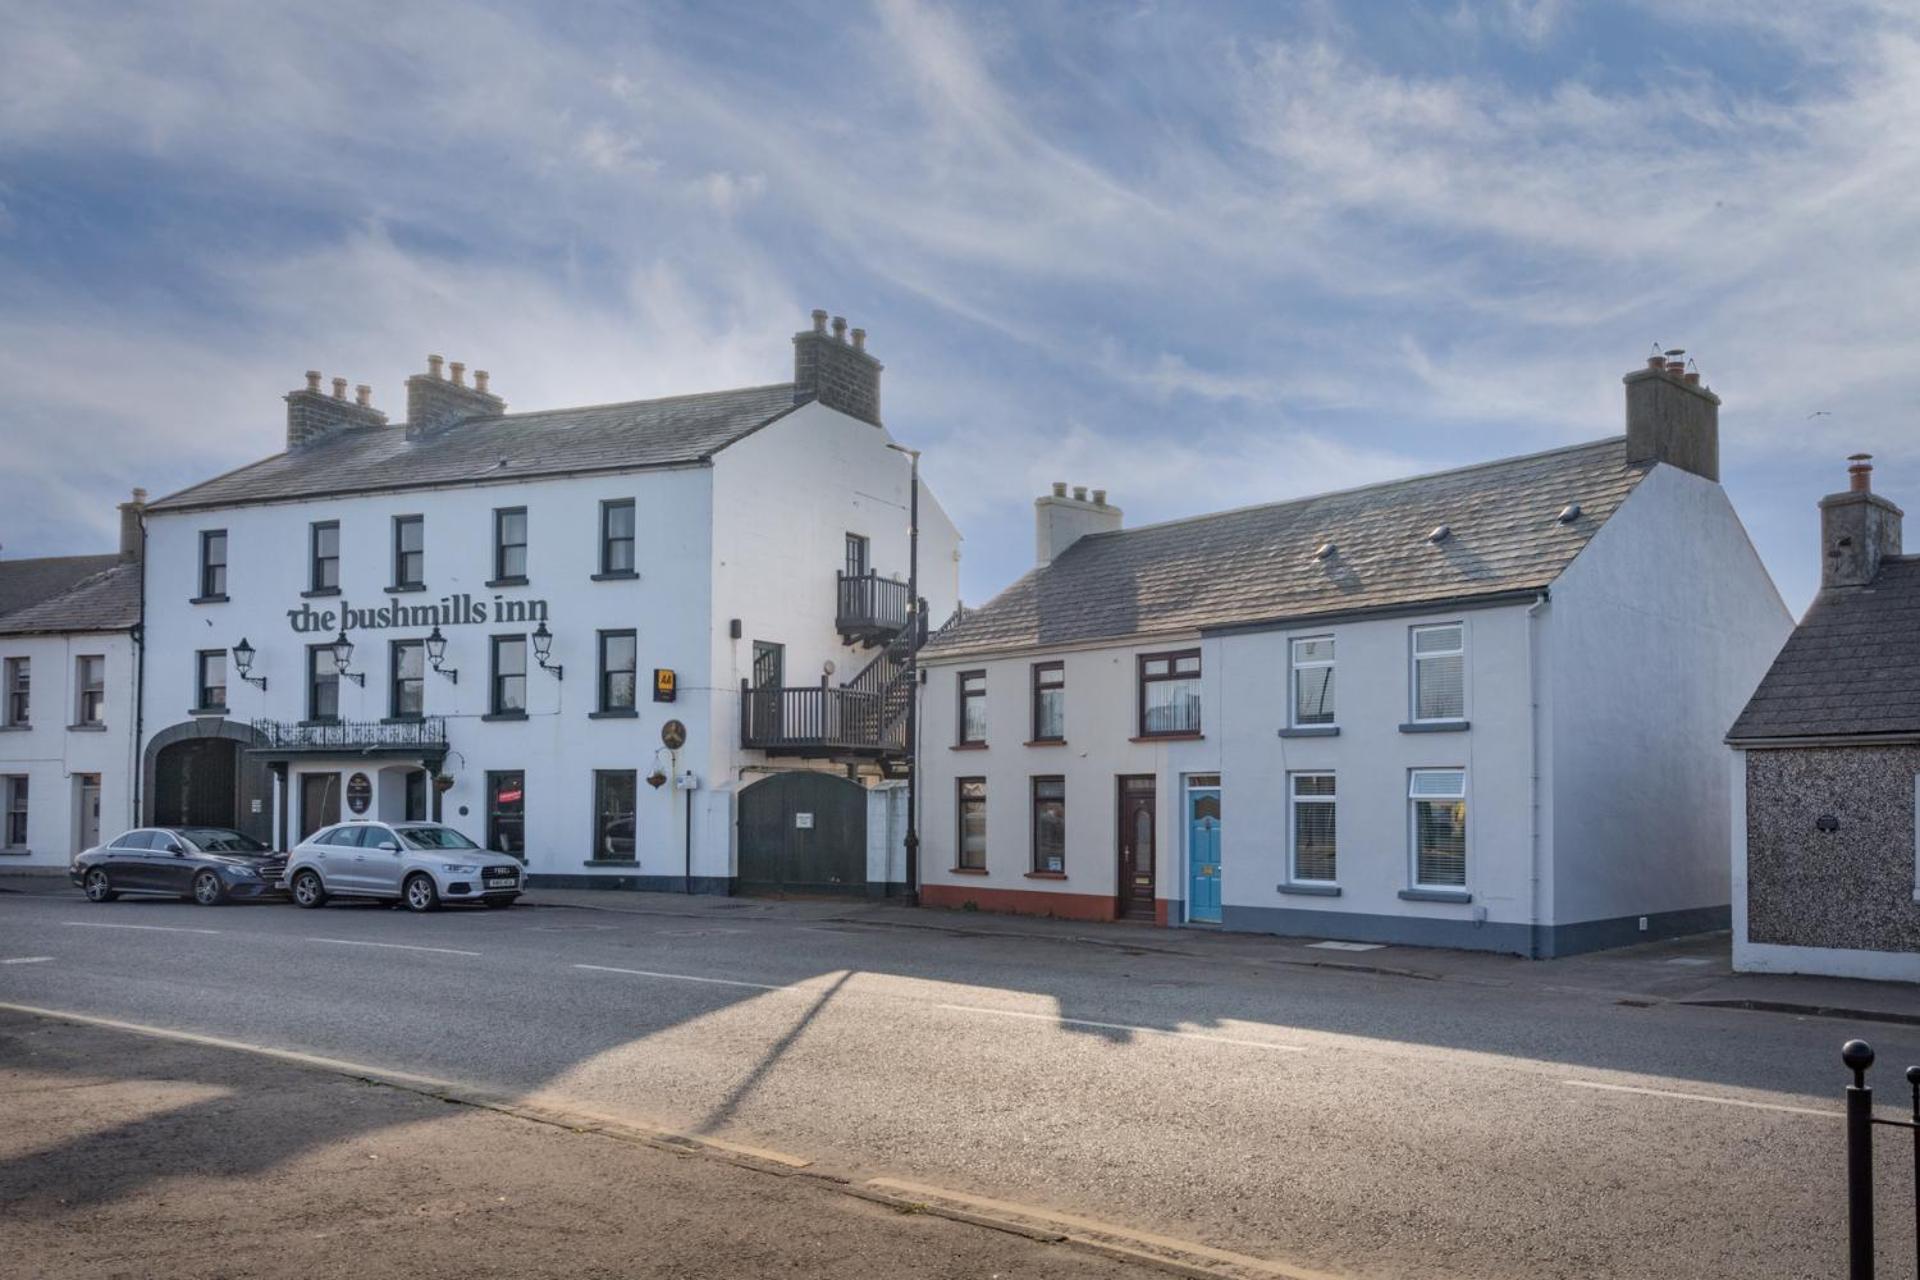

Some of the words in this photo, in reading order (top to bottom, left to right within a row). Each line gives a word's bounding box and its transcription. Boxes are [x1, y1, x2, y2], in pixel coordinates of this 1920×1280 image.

[287, 603, 336, 632] the
[340, 594, 487, 631] bushmills
[494, 595, 549, 622] inn
